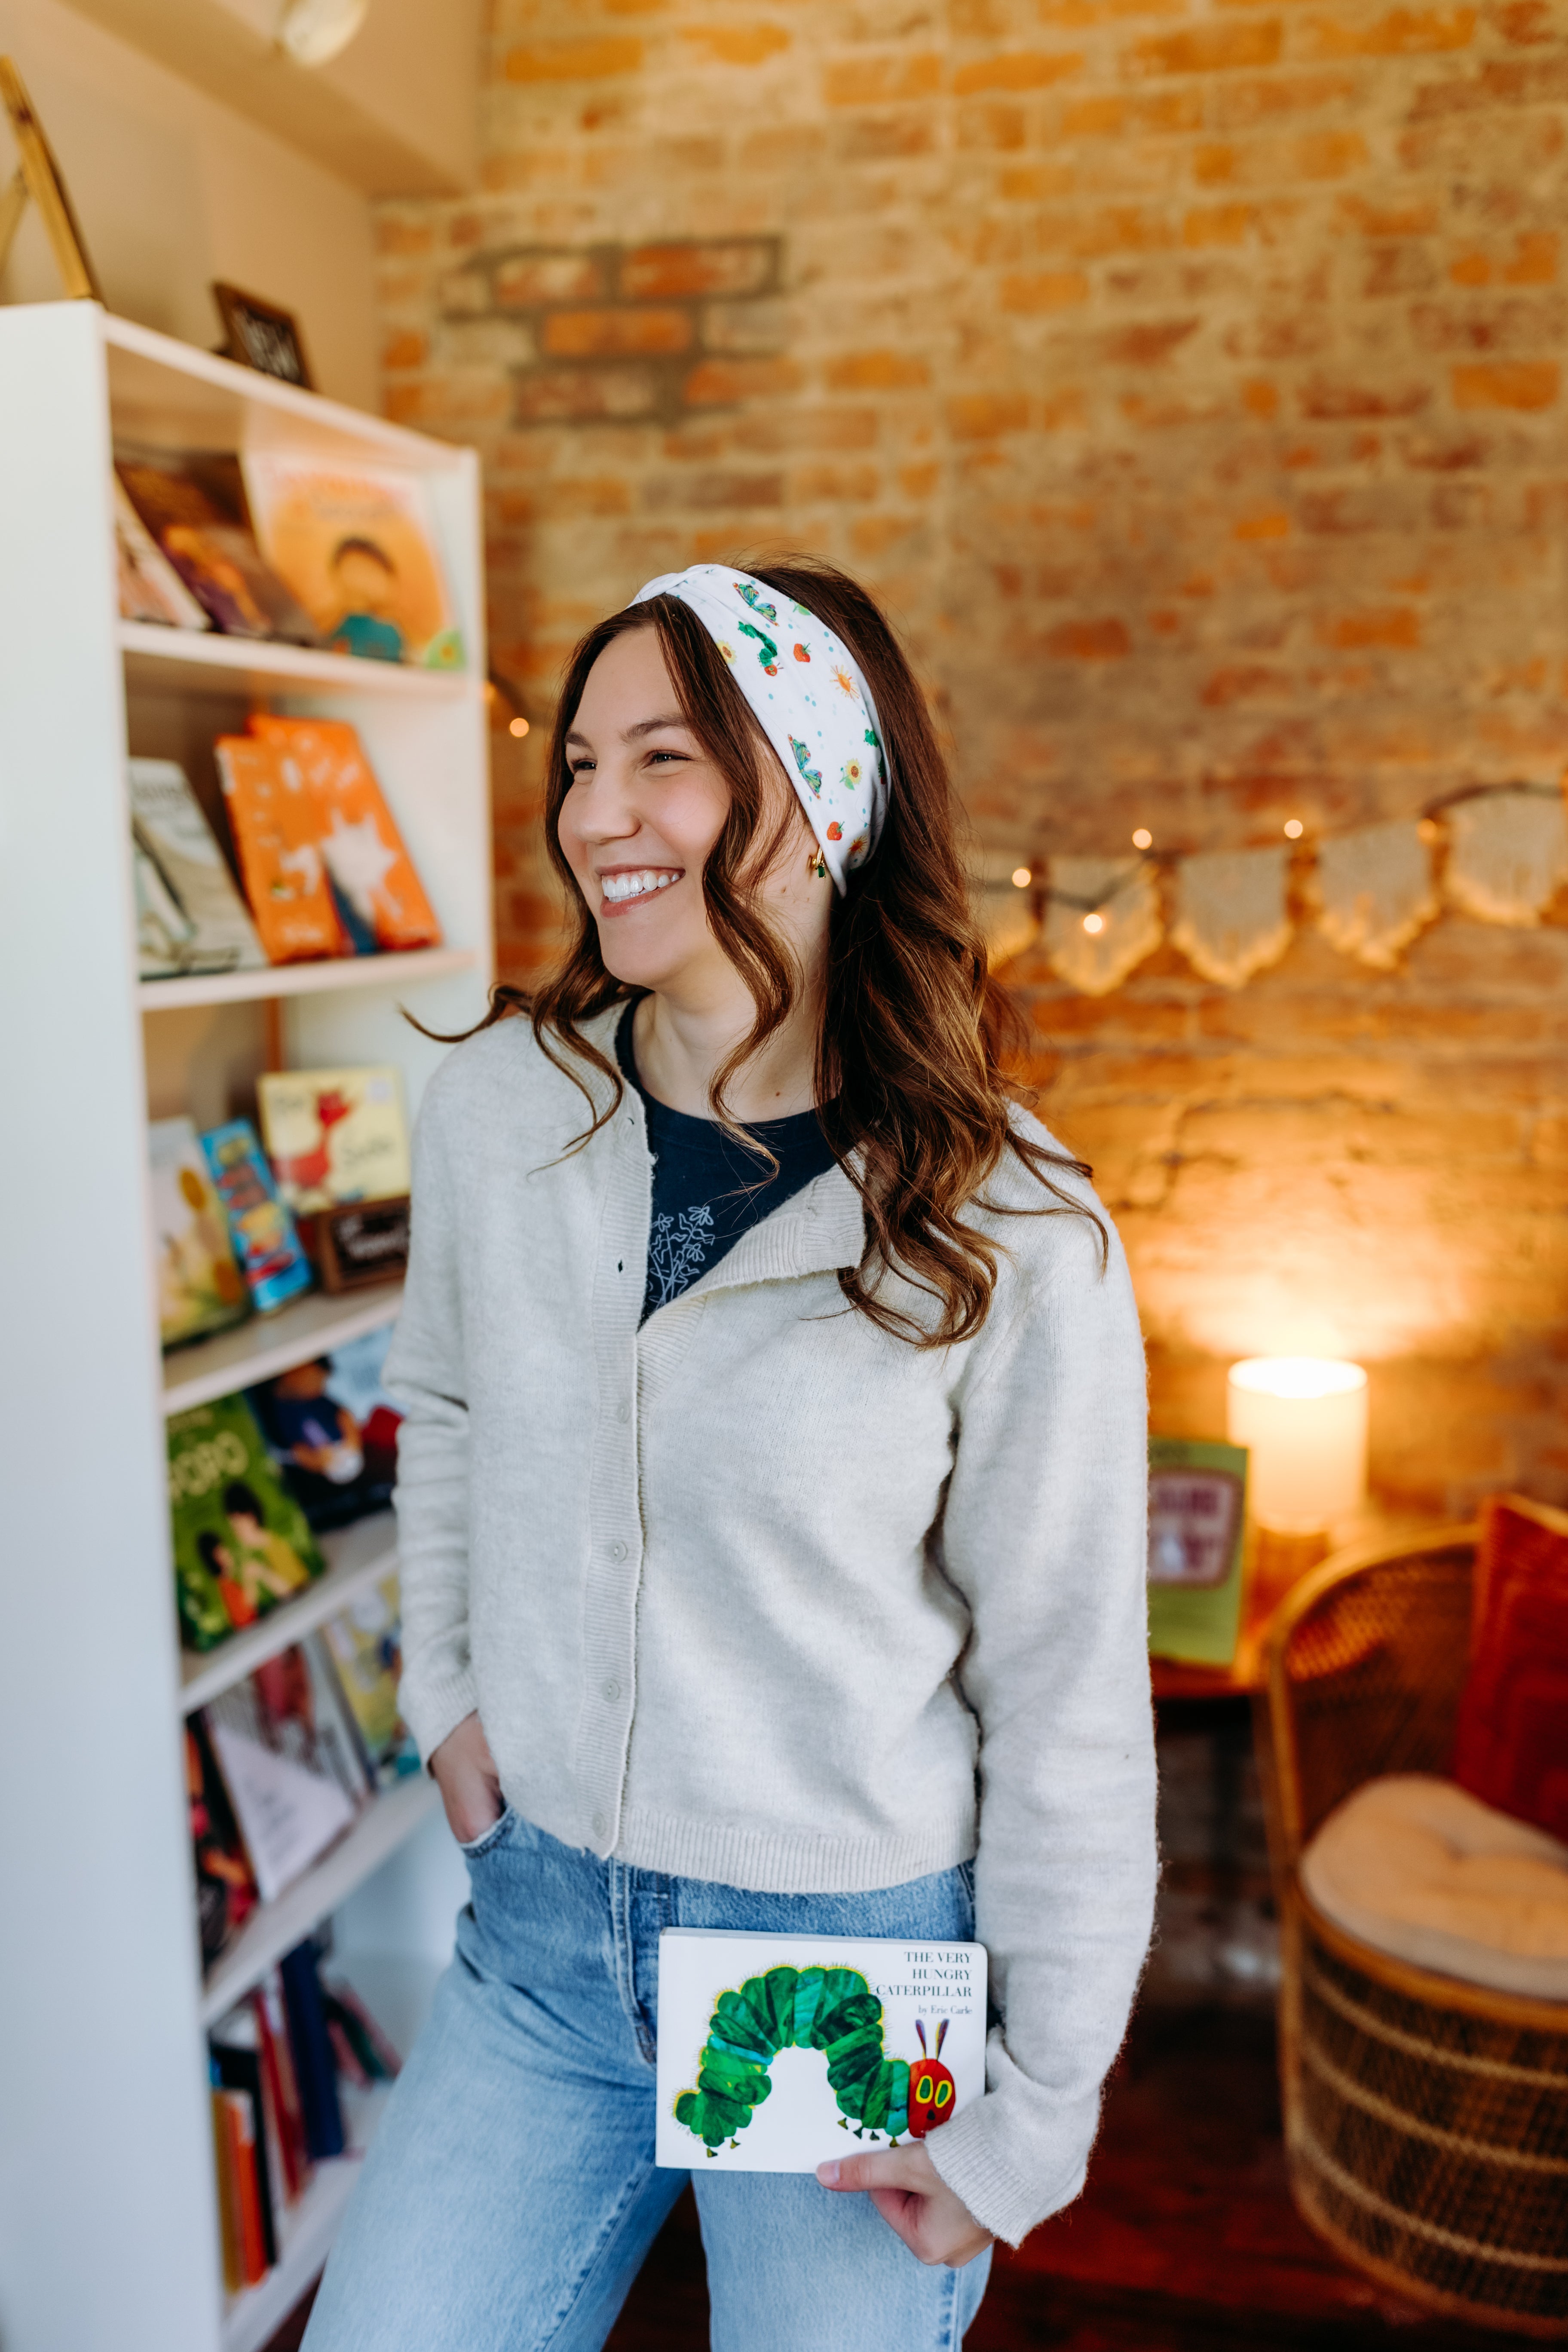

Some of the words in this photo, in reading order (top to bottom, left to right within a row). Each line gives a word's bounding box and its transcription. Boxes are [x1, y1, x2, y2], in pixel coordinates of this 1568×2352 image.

[904, 1951, 934, 1963] THE
[938, 1952, 972, 1963] VERY
[913, 1969, 972, 1980] HUNGRY
[876, 1984, 972, 1997] CATERPILLAR
[918, 2005, 928, 2015] by
[931, 2005, 948, 2014] Eric
[950, 2006, 973, 2014] Carle
